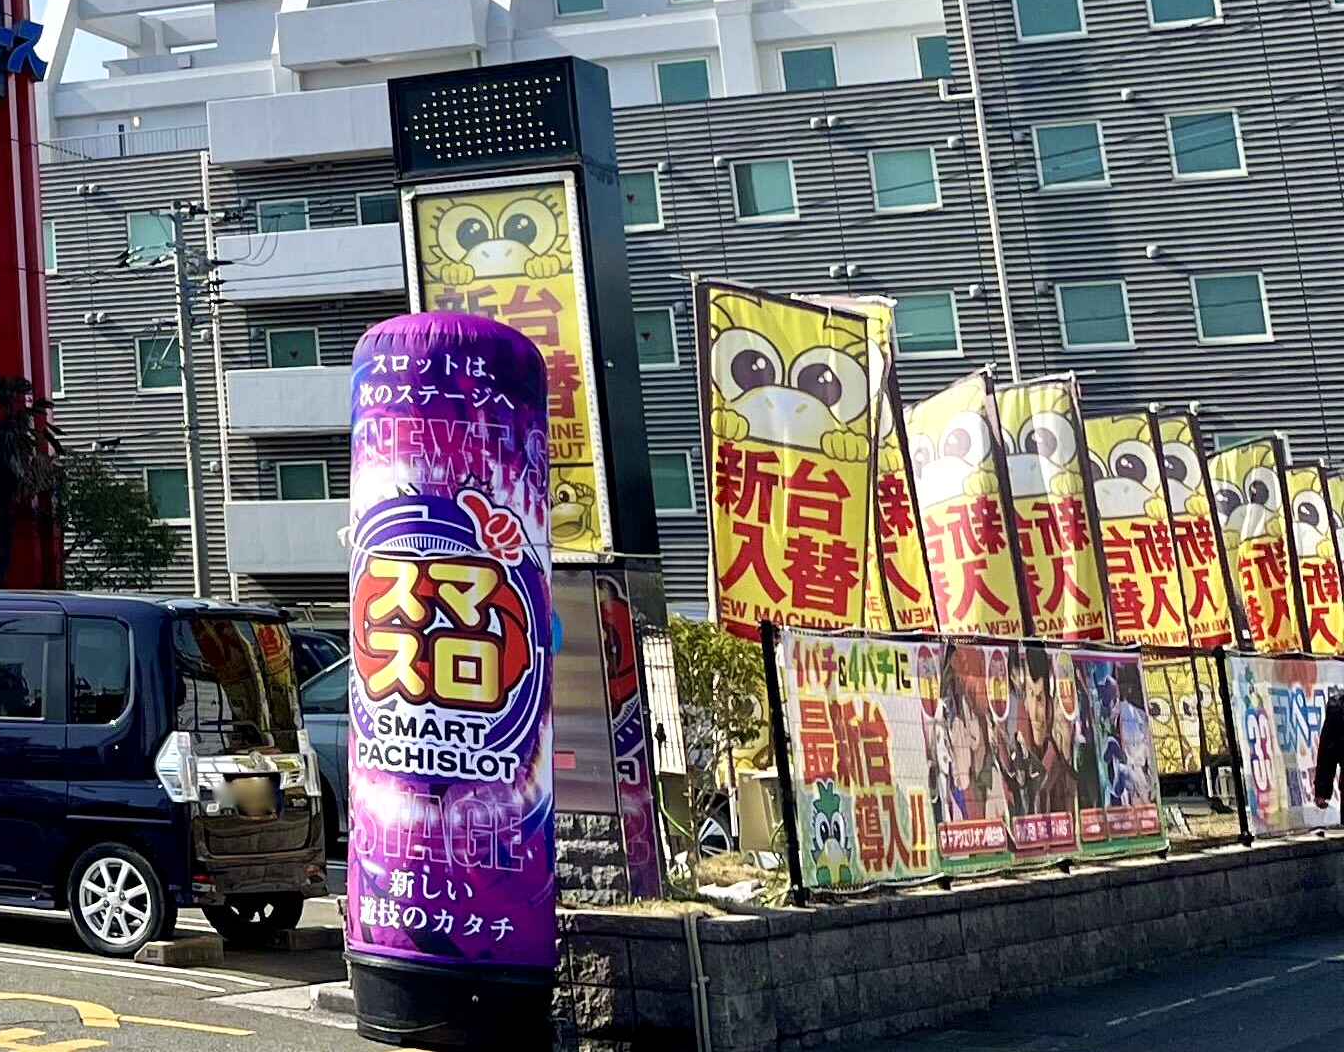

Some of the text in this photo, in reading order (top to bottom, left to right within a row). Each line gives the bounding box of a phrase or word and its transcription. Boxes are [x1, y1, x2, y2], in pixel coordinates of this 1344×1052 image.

[371, 353, 496, 380] スロットは、
[359, 383, 516, 410] 次のステージへ
[714, 441, 852, 536] 新台
[719, 521, 861, 617] 入替
[792, 640, 912, 694] 1パチ&4パチに
[377, 713, 487, 745] SMART
[799, 699, 892, 788] 最新台
[358, 742, 517, 780] PACHISLOT
[389, 868, 474, 900] 新しい
[359, 896, 515, 942] 遊技のカタチ
